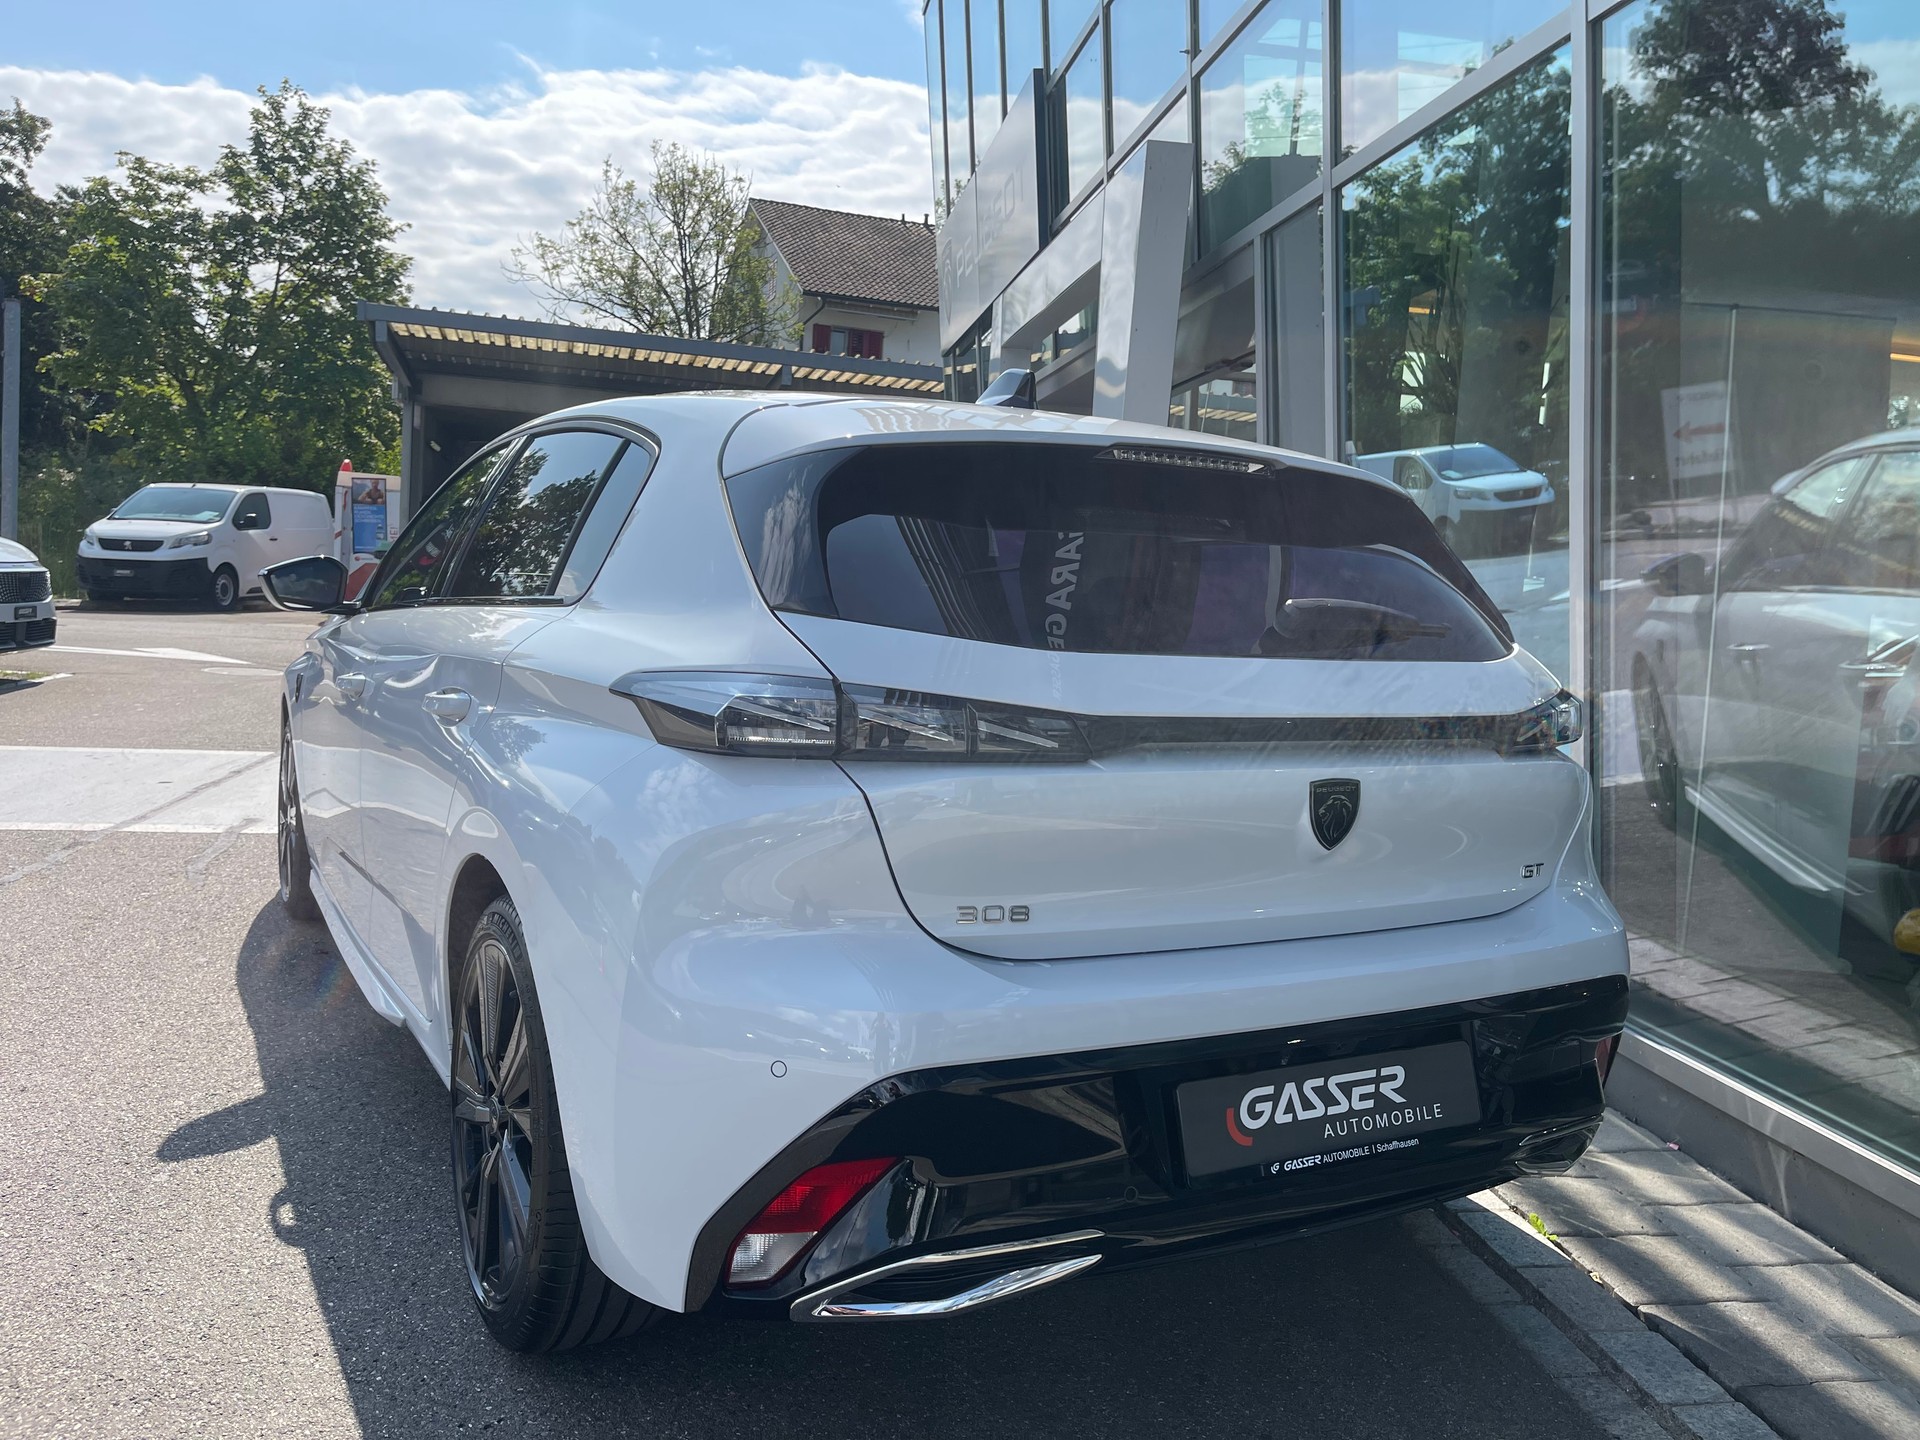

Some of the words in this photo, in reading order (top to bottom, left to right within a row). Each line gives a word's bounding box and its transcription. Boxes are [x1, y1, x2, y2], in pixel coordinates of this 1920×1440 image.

[1316, 785, 1357, 793] PEUGEOT
[1520, 863, 1545, 879] GT
[956, 905, 1030, 924] 308
[1239, 1065, 1407, 1130] GASSER
[1323, 1103, 1444, 1139] AUTOMOBILE
[1284, 1155, 1322, 1171] GASSER
[1322, 1146, 1371, 1164] AUTOMOBILE
[1376, 1138, 1420, 1153] Schaffhausen
